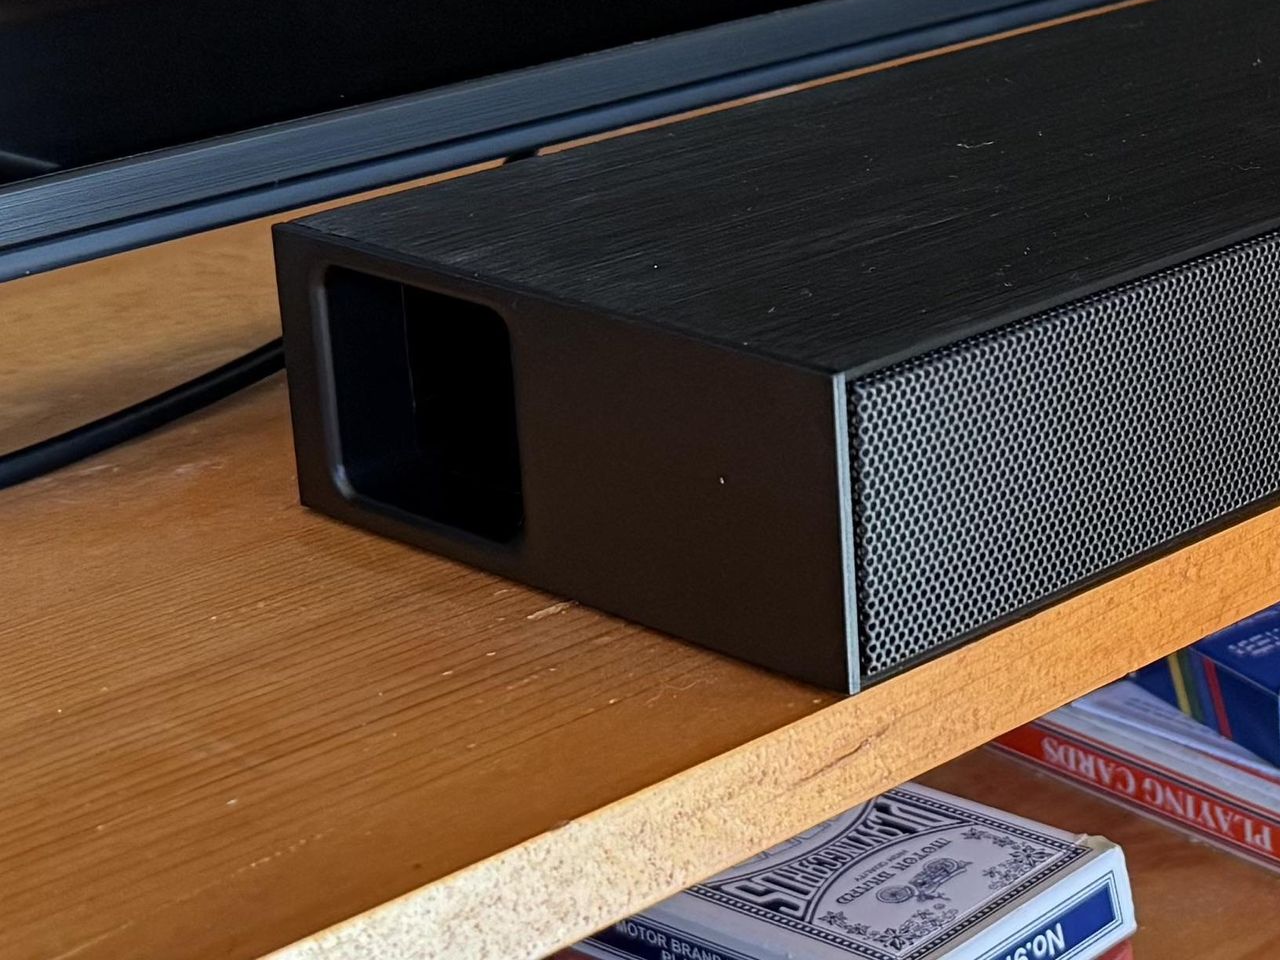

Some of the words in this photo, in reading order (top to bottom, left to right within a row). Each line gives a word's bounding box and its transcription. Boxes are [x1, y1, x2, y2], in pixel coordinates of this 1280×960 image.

[1040, 736, 1137, 796] CARDS
[1142, 776, 1274, 852] PLAYING
[890, 837, 952, 871] MOTOR
[614, 918, 668, 949] MOTOR
